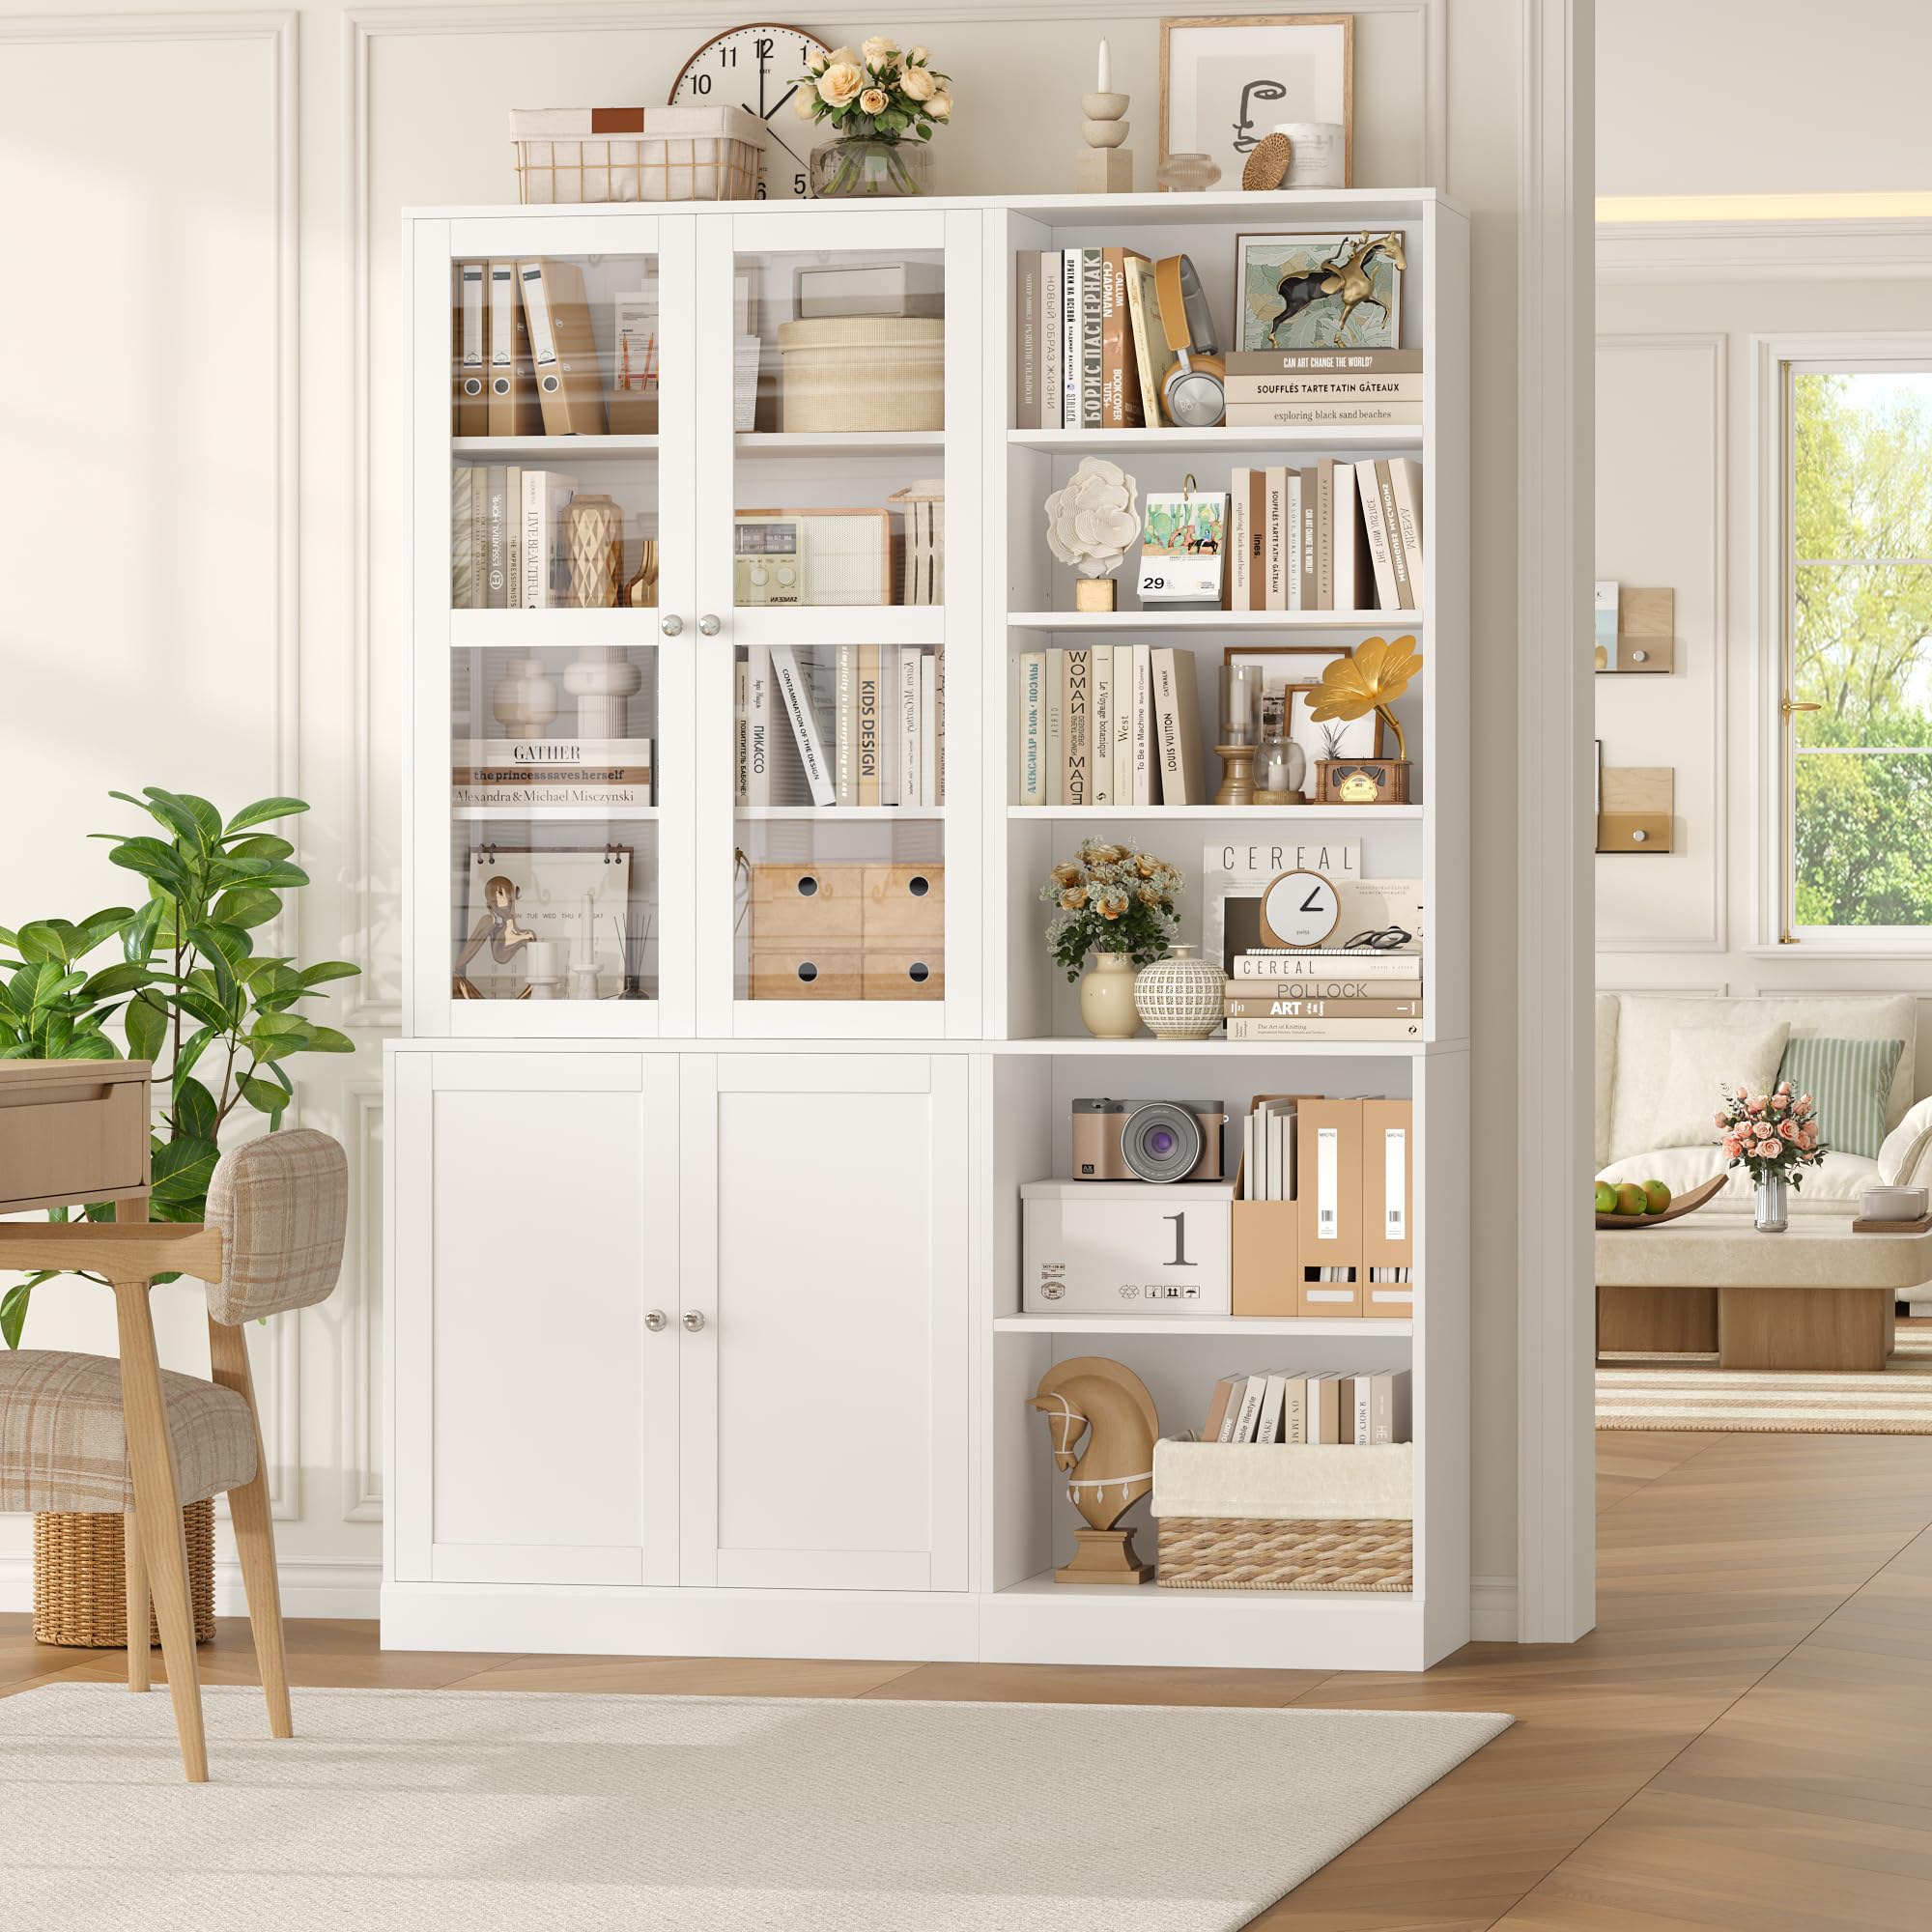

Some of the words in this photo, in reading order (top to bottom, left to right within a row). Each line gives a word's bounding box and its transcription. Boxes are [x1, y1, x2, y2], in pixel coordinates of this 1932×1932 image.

[719, 47, 737, 68] 11
[753, 38, 774, 59] 12
[689, 74, 712, 95] 10
[793, 174, 807, 194] 5
[1066, 259, 1075, 284] ПРЯТКИ
[1046, 275, 1057, 321] НОВЫЙ
[1066, 287, 1075, 296] НА
[1103, 261, 1113, 318] CHAPMAN
[1115, 271, 1123, 307] CALLUM
[1066, 298, 1076, 323] ОСЕВОЙ
[1084, 254, 1100, 359] ПАСТЕРНАК
[1046, 324, 1056, 359] ОБРАЗ
[1283, 358, 1296, 368] CAN
[1297, 357, 1309, 368] ART
[1310, 356, 1334, 368] CHANGE
[1335, 356, 1347, 367] THE
[1348, 356, 1373, 367] WORLD?
[1046, 363, 1056, 410] ЖИЗНИ
[1084, 361, 1100, 422] БОРИС
[1113, 368, 1122, 393] BOOK
[1257, 383, 1299, 394] SOUFFLÉS
[1301, 384, 1328, 393] TARTE
[1330, 384, 1356, 392] TATIN
[1359, 382, 1400, 392] GÂTEAUX
[1113, 394, 1122, 421] COVER
[1273, 411, 1313, 422] exploring
[1315, 410, 1337, 419] black
[1338, 410, 1358, 419] sand
[1358, 410, 1392, 419] beaches
[527, 511, 538, 537] LIVE
[527, 539, 538, 601] BEAUTIFUL
[1143, 577, 1165, 589] 29
[840, 645, 849, 692] simplicity
[1029, 663, 1039, 702] ПОЭМЫ
[1099, 681, 1109, 691] Le
[782, 668, 804, 728] CONTAMINATION
[862, 680, 875, 716] KIDS
[1097, 693, 1109, 720] Voyage
[800, 728, 808, 739] OF
[1029, 708, 1037, 735] БЛОК
[1118, 715, 1129, 742] West
[1164, 713, 1175, 747] VUITTON
[753, 725, 764, 774] ПИКАССО
[803, 739, 812, 754] THE
[840, 717, 849, 764] everything
[862, 720, 875, 776] DESIGN
[1097, 721, 1109, 758] botanique
[514, 745, 581, 760] GATHER
[1137, 750, 1145, 760] Be
[1168, 748, 1178, 772] LOUIS
[474, 770, 494, 781] the
[496, 770, 547, 782] princess
[547, 772, 580, 781] saves
[582, 770, 625, 781] herself
[807, 753, 820, 781] DESIGN
[1027, 737, 1037, 794] АЛЕКСАНДР
[1137, 761, 1145, 771] To
[456, 790, 512, 802] Alexandra
[512, 791, 523, 802] &
[523, 790, 569, 802] Michael
[572, 790, 635, 804] Misczynski
[1223, 846, 1352, 869] CEREAL
[1243, 960, 1315, 975] CEREAL
[1277, 983, 1368, 998] POLLOCK
[1270, 1002, 1302, 1014] ART
[1162, 1211, 1199, 1265] 1
[1242, 1396, 1257, 1424] lifestyle
[1292, 1400, 1299, 1413] ON
[1221, 1417, 1234, 1442] GUIDE
